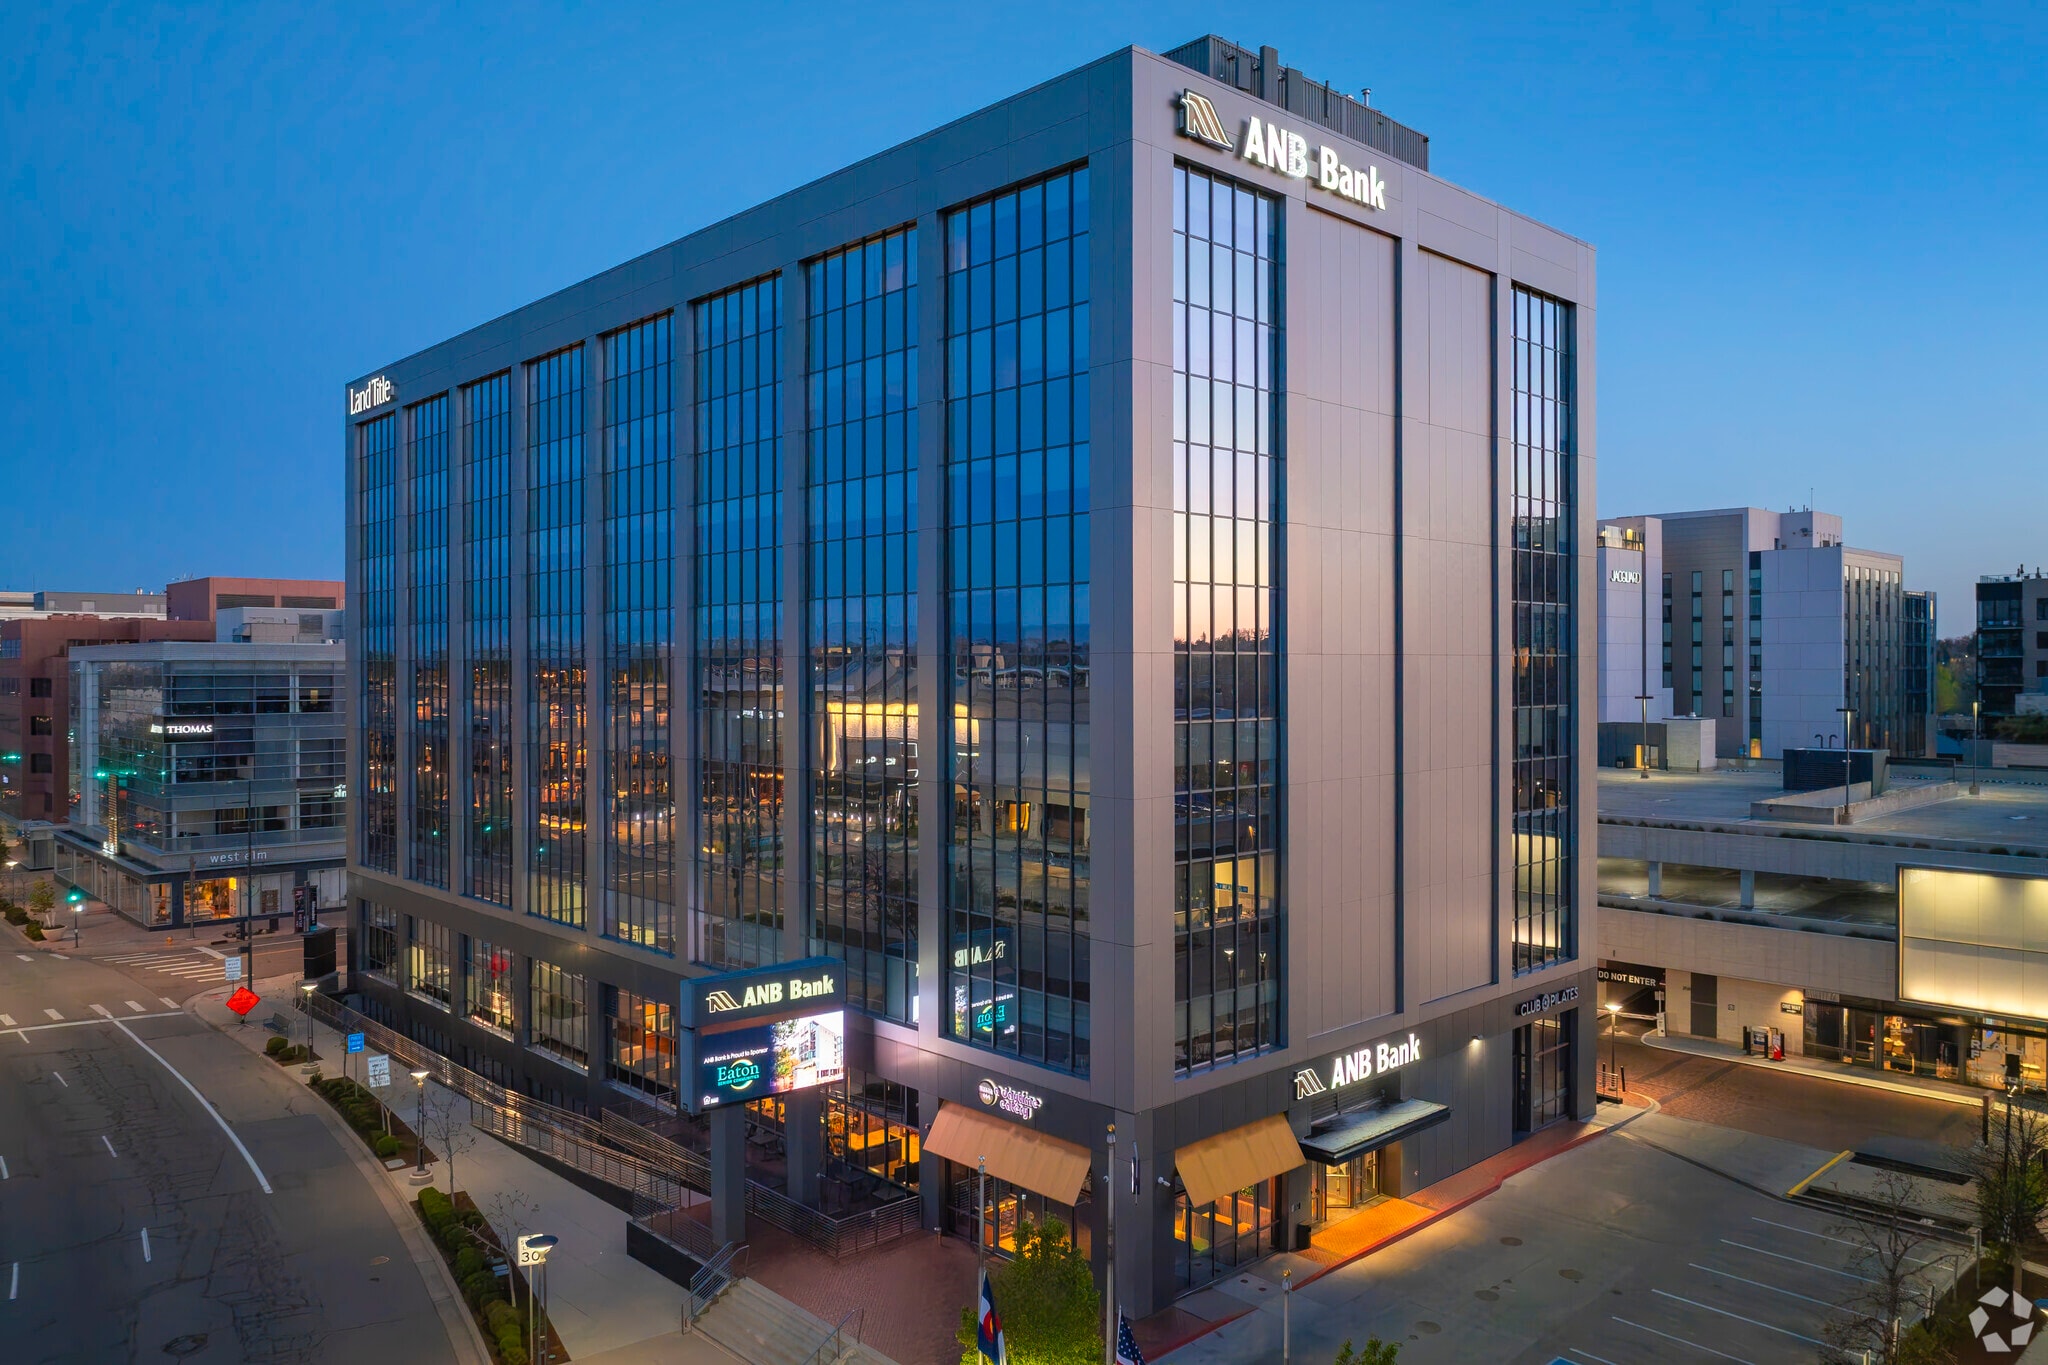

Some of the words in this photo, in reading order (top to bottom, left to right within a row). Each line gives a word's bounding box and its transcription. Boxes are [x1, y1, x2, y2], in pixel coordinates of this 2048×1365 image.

[1243, 116, 1308, 178] ANB
[1319, 144, 1386, 211] Bank
[350, 381, 371, 415] Land
[371, 375, 391, 406] Title
[166, 725, 213, 734] THOMAS
[210, 851, 240, 863] west
[1598, 970, 1610, 980] DO
[1611, 972, 1628, 983] NOT
[1629, 975, 1657, 987] ENTER
[743, 982, 783, 1008] ANB
[789, 975, 834, 1000] Bank
[1520, 999, 1541, 1017] CLUB
[1550, 986, 1579, 1007] PILATES
[717, 1065, 760, 1081] Eaton
[1331, 1048, 1372, 1090] ANB
[1376, 1033, 1420, 1073] Bank
[521, 1250, 541, 1263] 30
